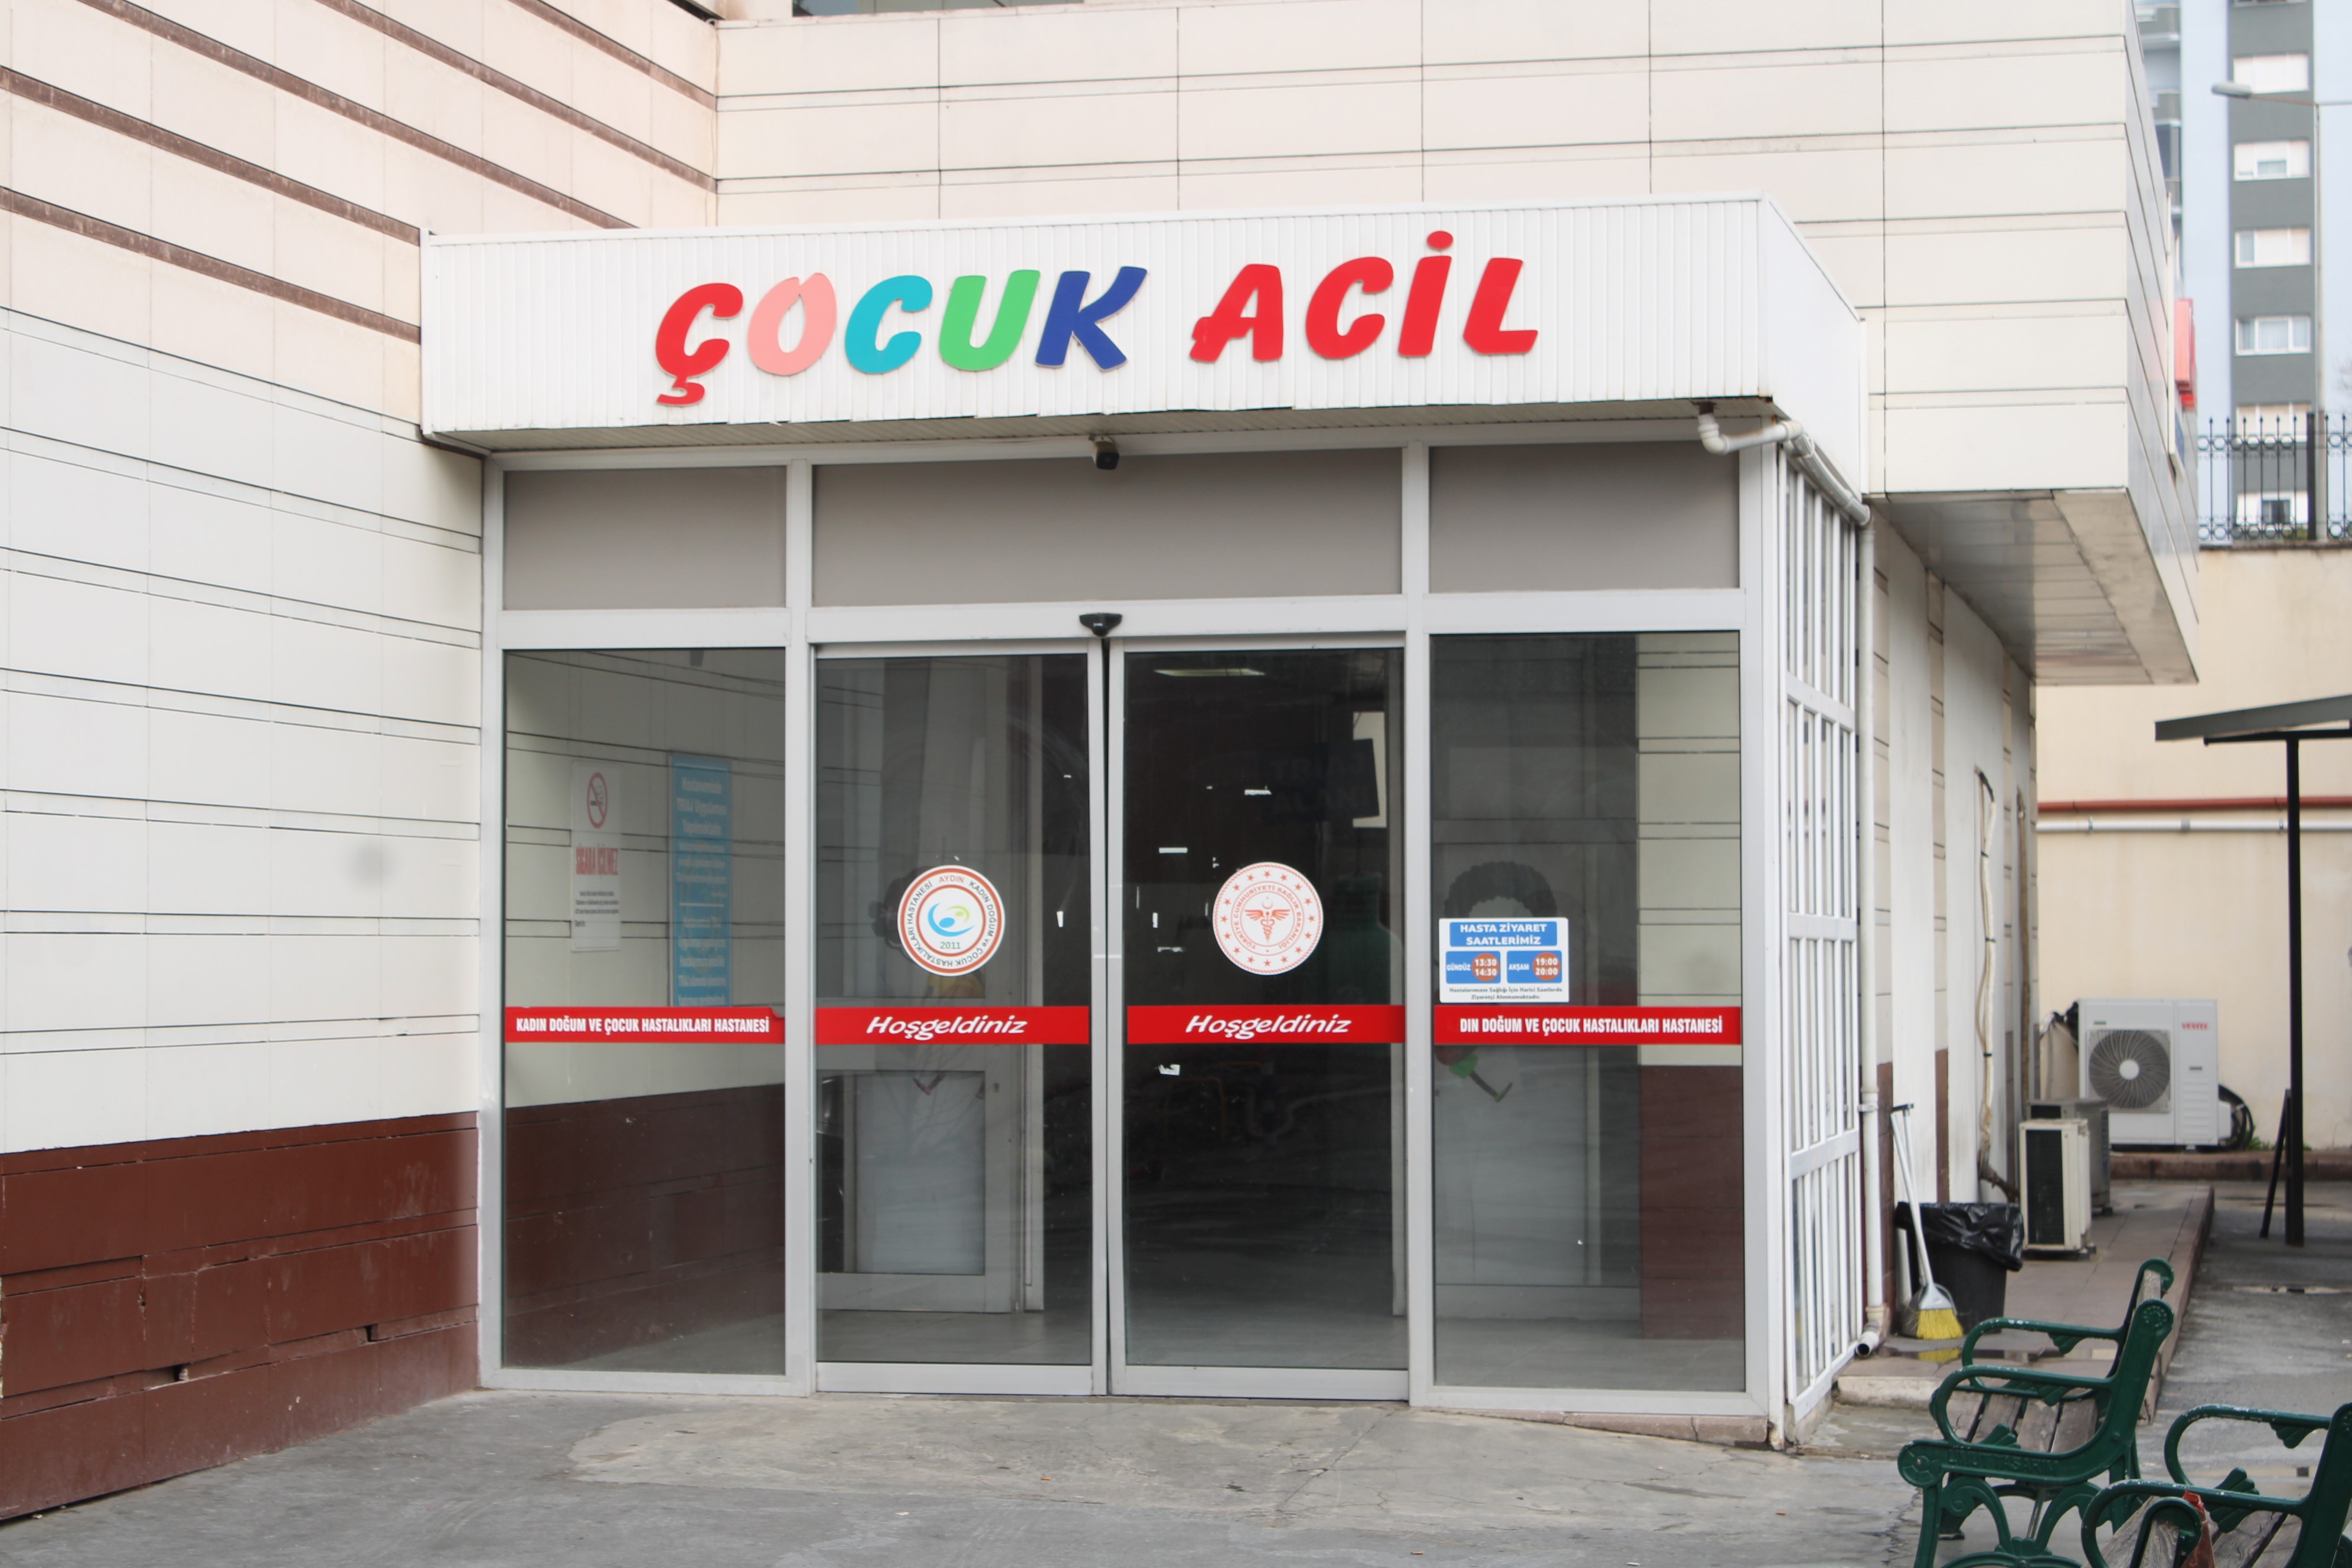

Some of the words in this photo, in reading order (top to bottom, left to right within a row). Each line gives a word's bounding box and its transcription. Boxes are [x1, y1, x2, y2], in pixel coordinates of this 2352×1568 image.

[655, 265, 1147, 406] ÇOCUK
[1190, 230, 1539, 362] ACİL
[939, 875, 964, 883] AYDIN
[969, 880, 990, 903] KADIN
[907, 881, 933, 925] HASTANESİ
[986, 904, 997, 937] DOĞUM
[1460, 924, 1497, 933] HASTA
[1499, 922, 1547, 932] ZİYARET
[907, 926, 953, 966] HASTALIKLARI
[982, 939, 989, 948] ve
[1466, 935, 1541, 945] SAATLERİMİZ
[955, 947, 984, 966] ÇOCUK
[1475, 958, 1497, 966] 13:30
[1535, 958, 1558, 966] 19:00
[1446, 963, 1471, 971] GÜNDÜZ
[1475, 968, 1497, 976] 14:30
[1535, 968, 1558, 976] 20:00
[517, 1018, 547, 1031] KADIN
[550, 1015, 586, 1032] DOĞUM
[589, 1018, 602, 1031] VE
[605, 1018, 639, 1035] ÇOCUK
[642, 1018, 711, 1032] HASTALIKLARI
[714, 1016, 769, 1033] HASTANESİ
[866, 1015, 1028, 1041] Hoşgeldiniz
[1185, 1014, 1352, 1040] Hoşgeldiniz
[1459, 1018, 1479, 1033] DIN
[1482, 1015, 1522, 1033] DOĞUM
[1525, 1018, 1539, 1033] VE
[1542, 1018, 1580, 1037] ÇOCUK
[1583, 1018, 1659, 1033] HASTALIKLARI
[1662, 1015, 1722, 1033] HASTANESİ
